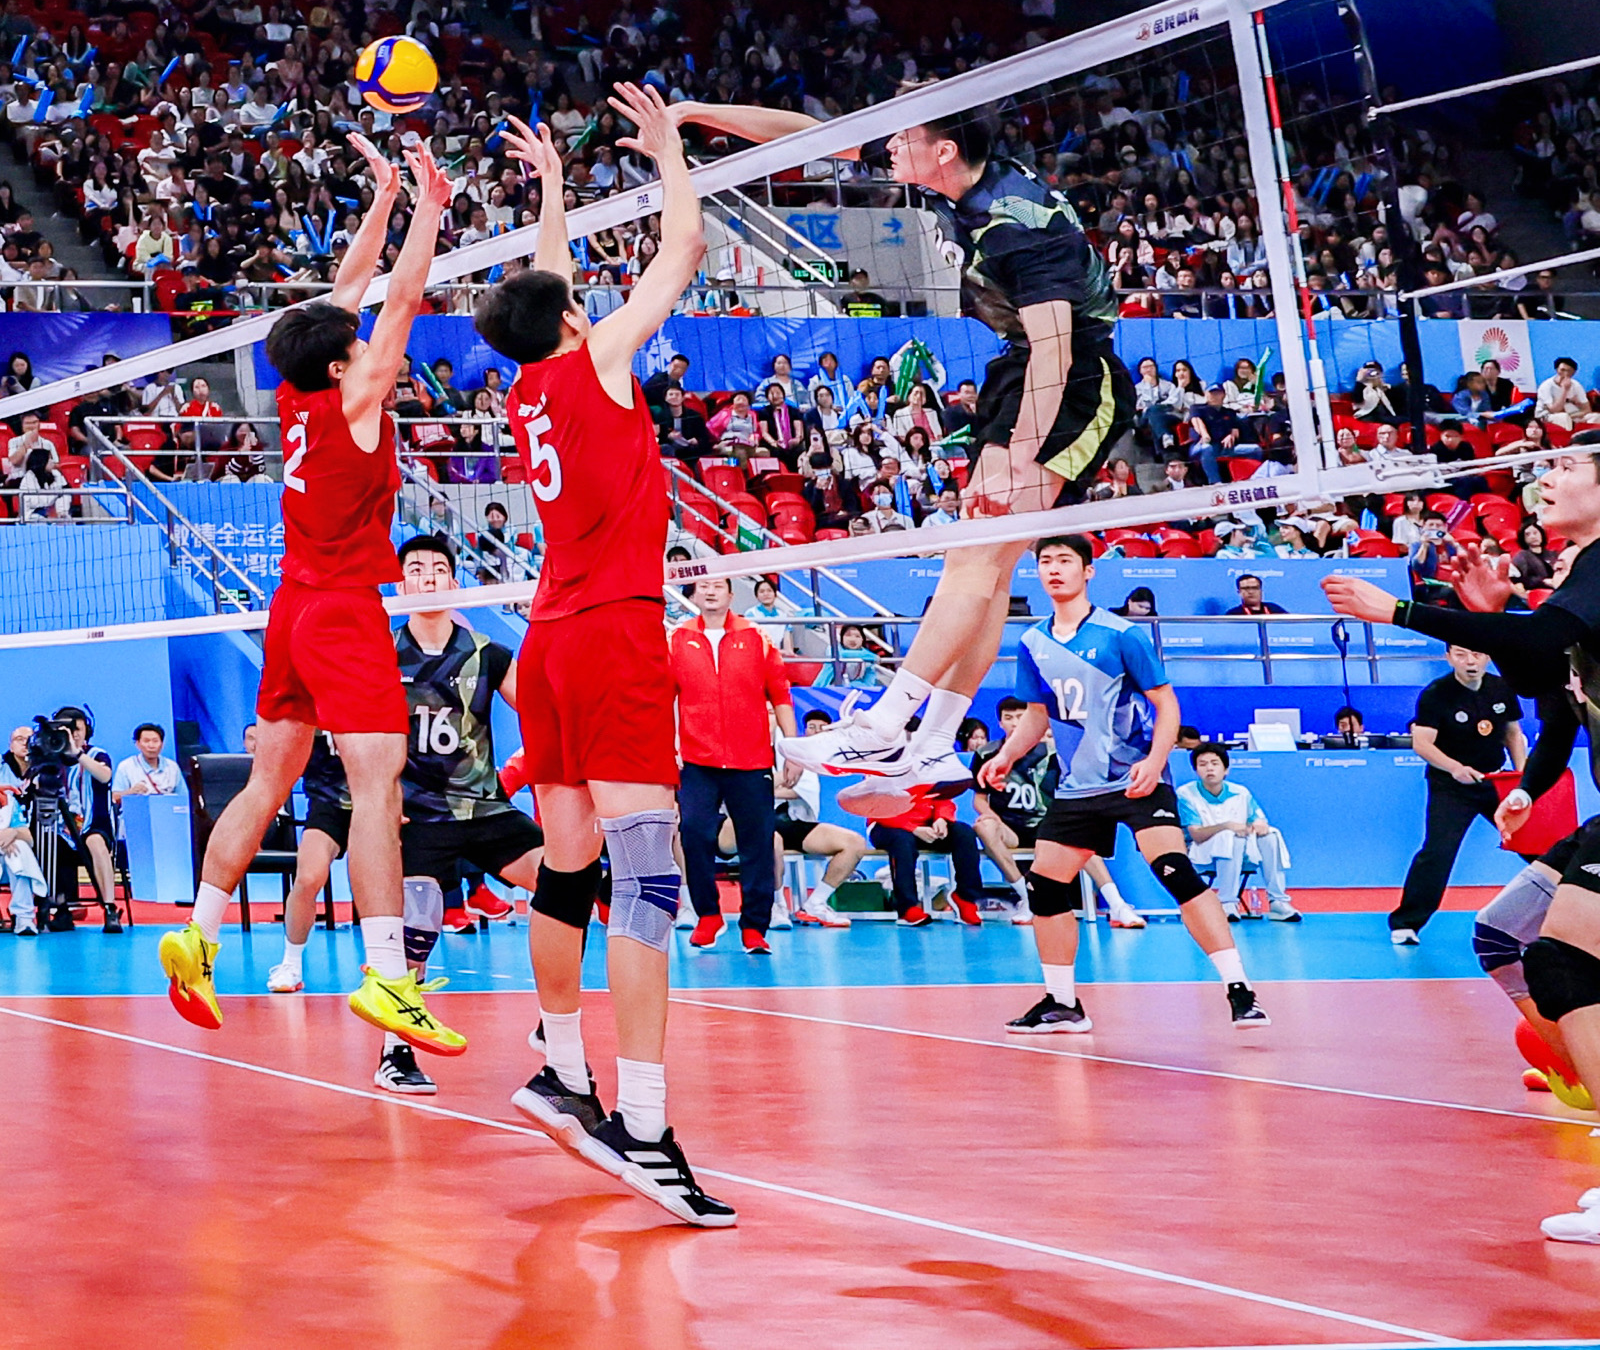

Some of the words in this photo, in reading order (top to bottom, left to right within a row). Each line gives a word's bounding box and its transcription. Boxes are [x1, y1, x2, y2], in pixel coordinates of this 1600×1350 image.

[284, 424, 307, 494] 2
[524, 414, 562, 502] 5
[1052, 678, 1088, 720] 12
[414, 705, 460, 755] 16
[1005, 782, 1036, 810] 20
